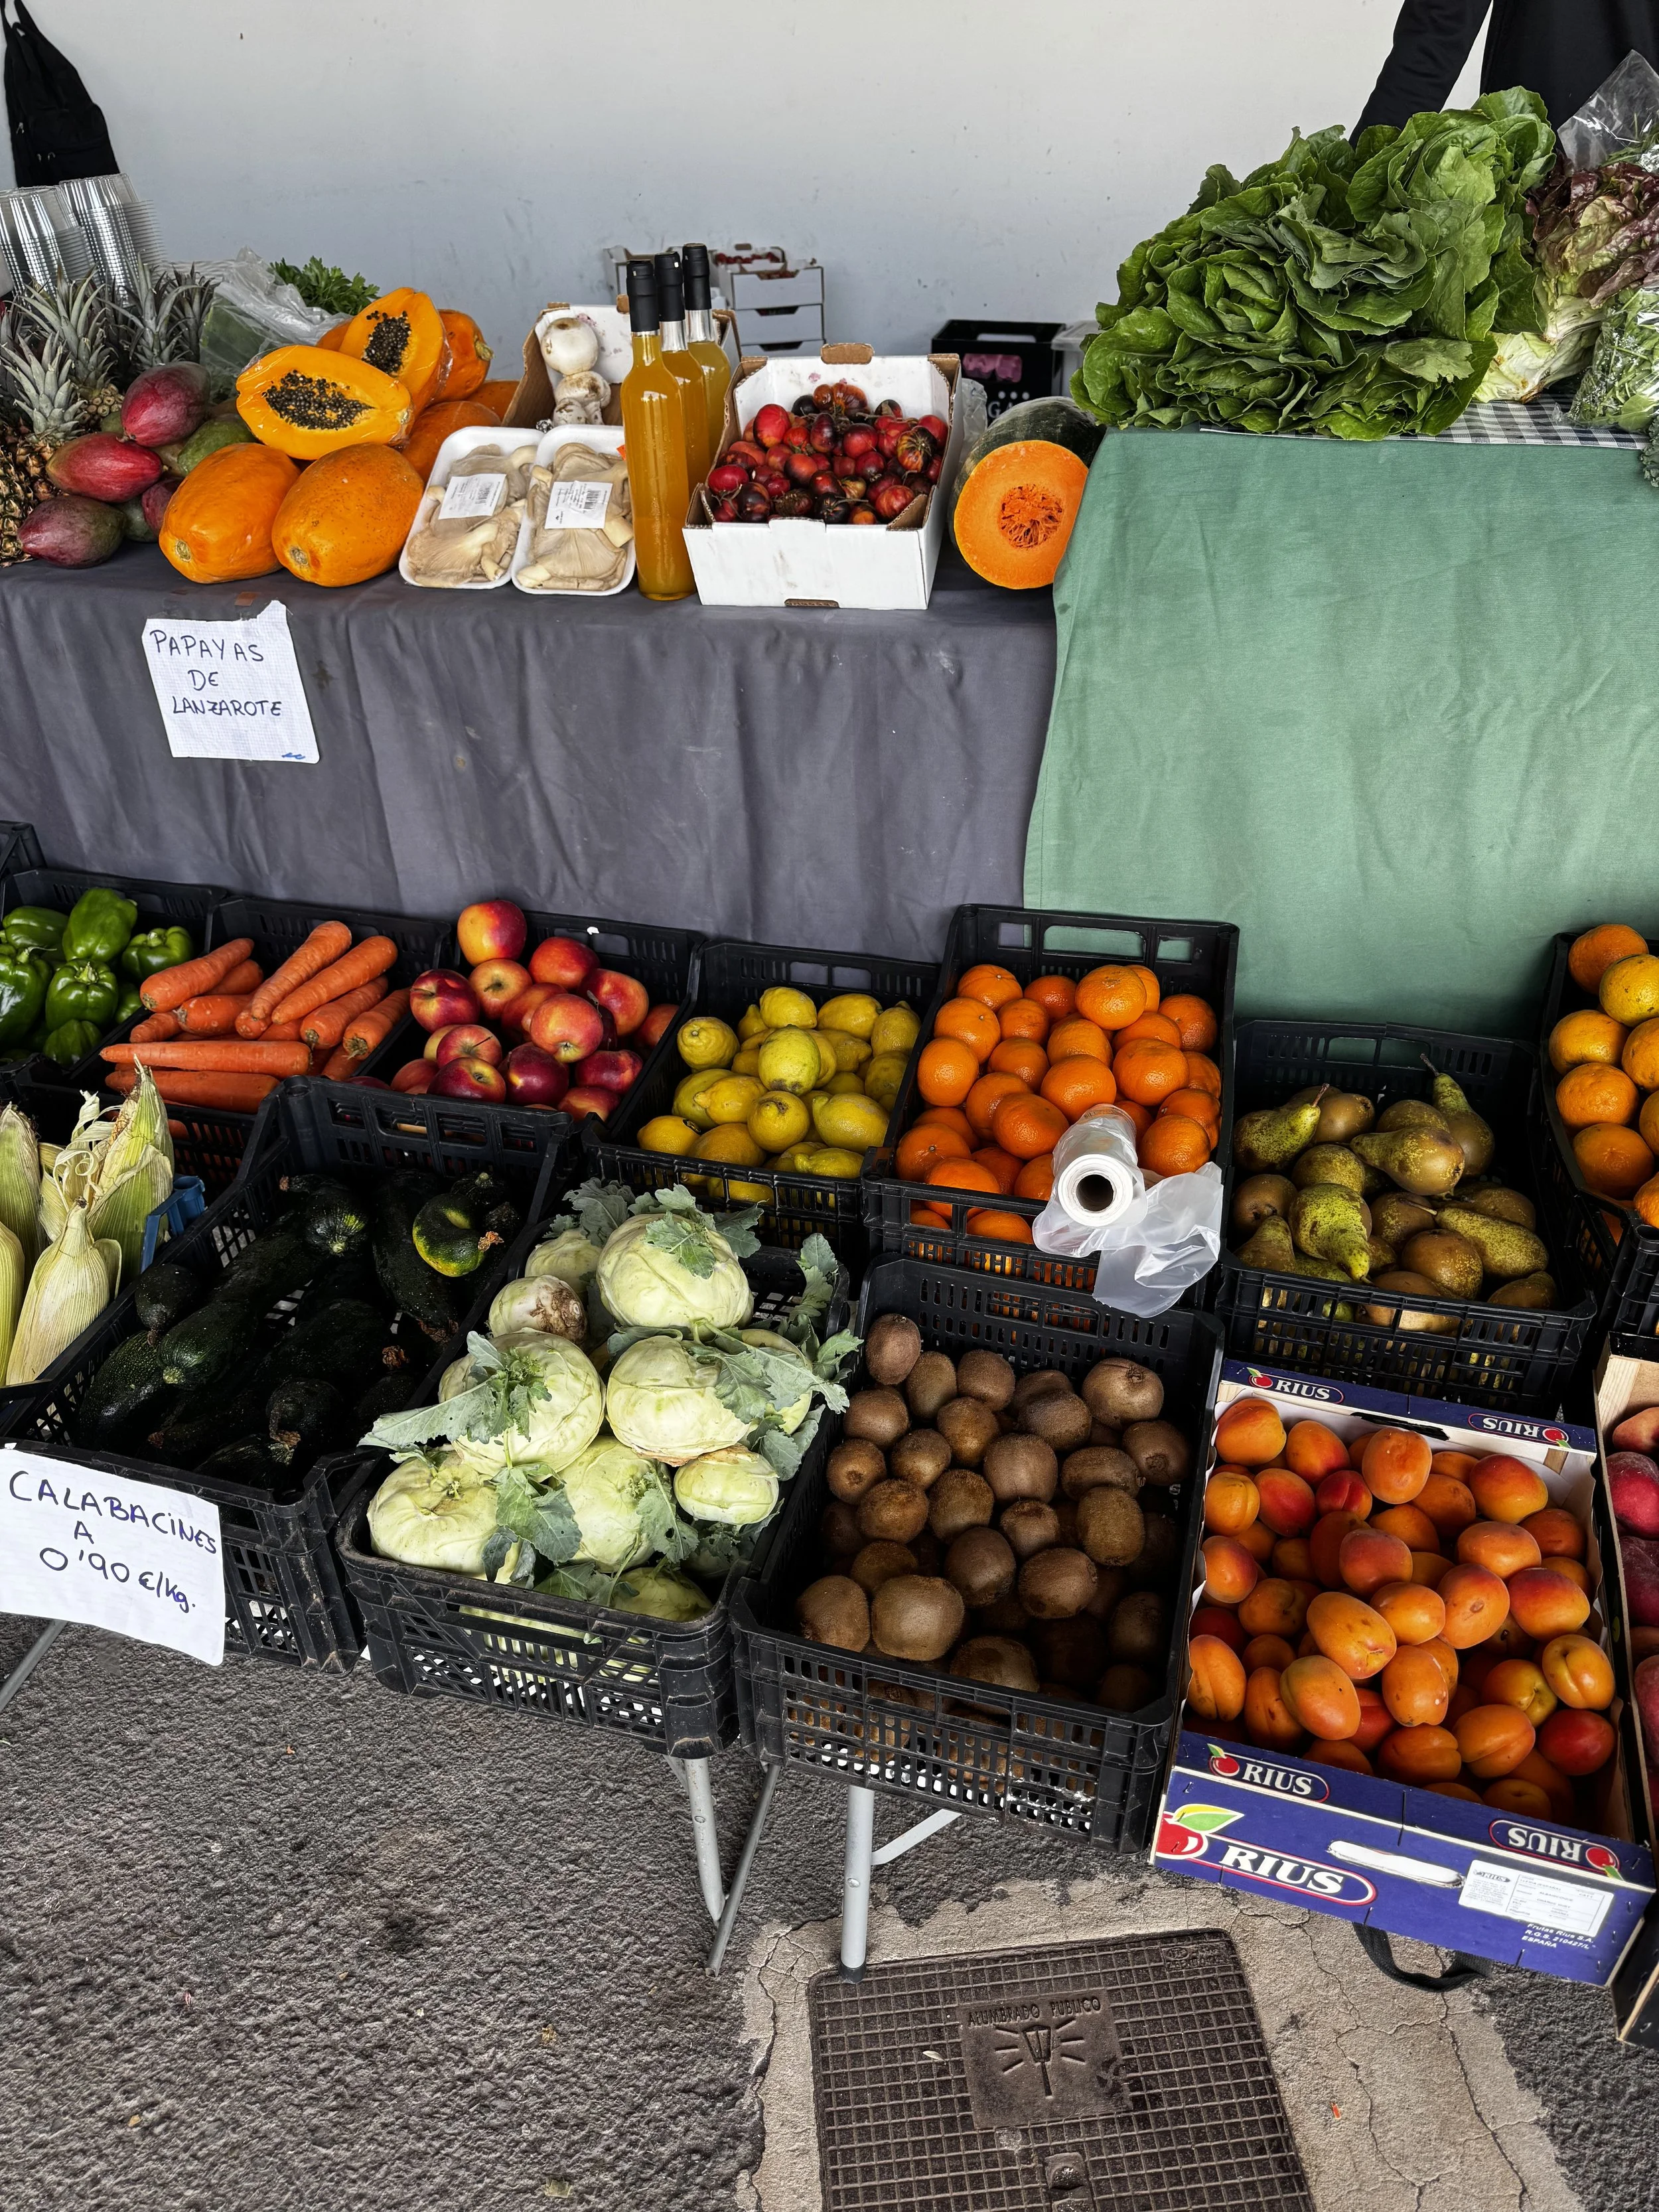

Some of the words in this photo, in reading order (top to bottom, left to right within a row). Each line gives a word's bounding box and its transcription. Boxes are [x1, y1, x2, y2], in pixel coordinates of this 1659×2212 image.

[149, 629, 264, 662] PAPAYAS
[187, 669, 219, 692] DE
[172, 696, 282, 717] LANZAROTE
[1274, 1379, 1330, 1400] RIUS
[1482, 1417, 1540, 1438] RIUS
[74, 1520, 95, 1544] A
[1242, 1762, 1312, 1796] RIUS
[1508, 1827, 1583, 1862] RIUS
[1218, 1844, 1344, 1894] RIUS
[1521, 1935, 1557, 1949] ESPAÑA
[1524, 1929, 1551, 1939] R.G.S.
[1527, 1923, 1554, 1933] Frutas
[1555, 1930, 1575, 1939] Rius
